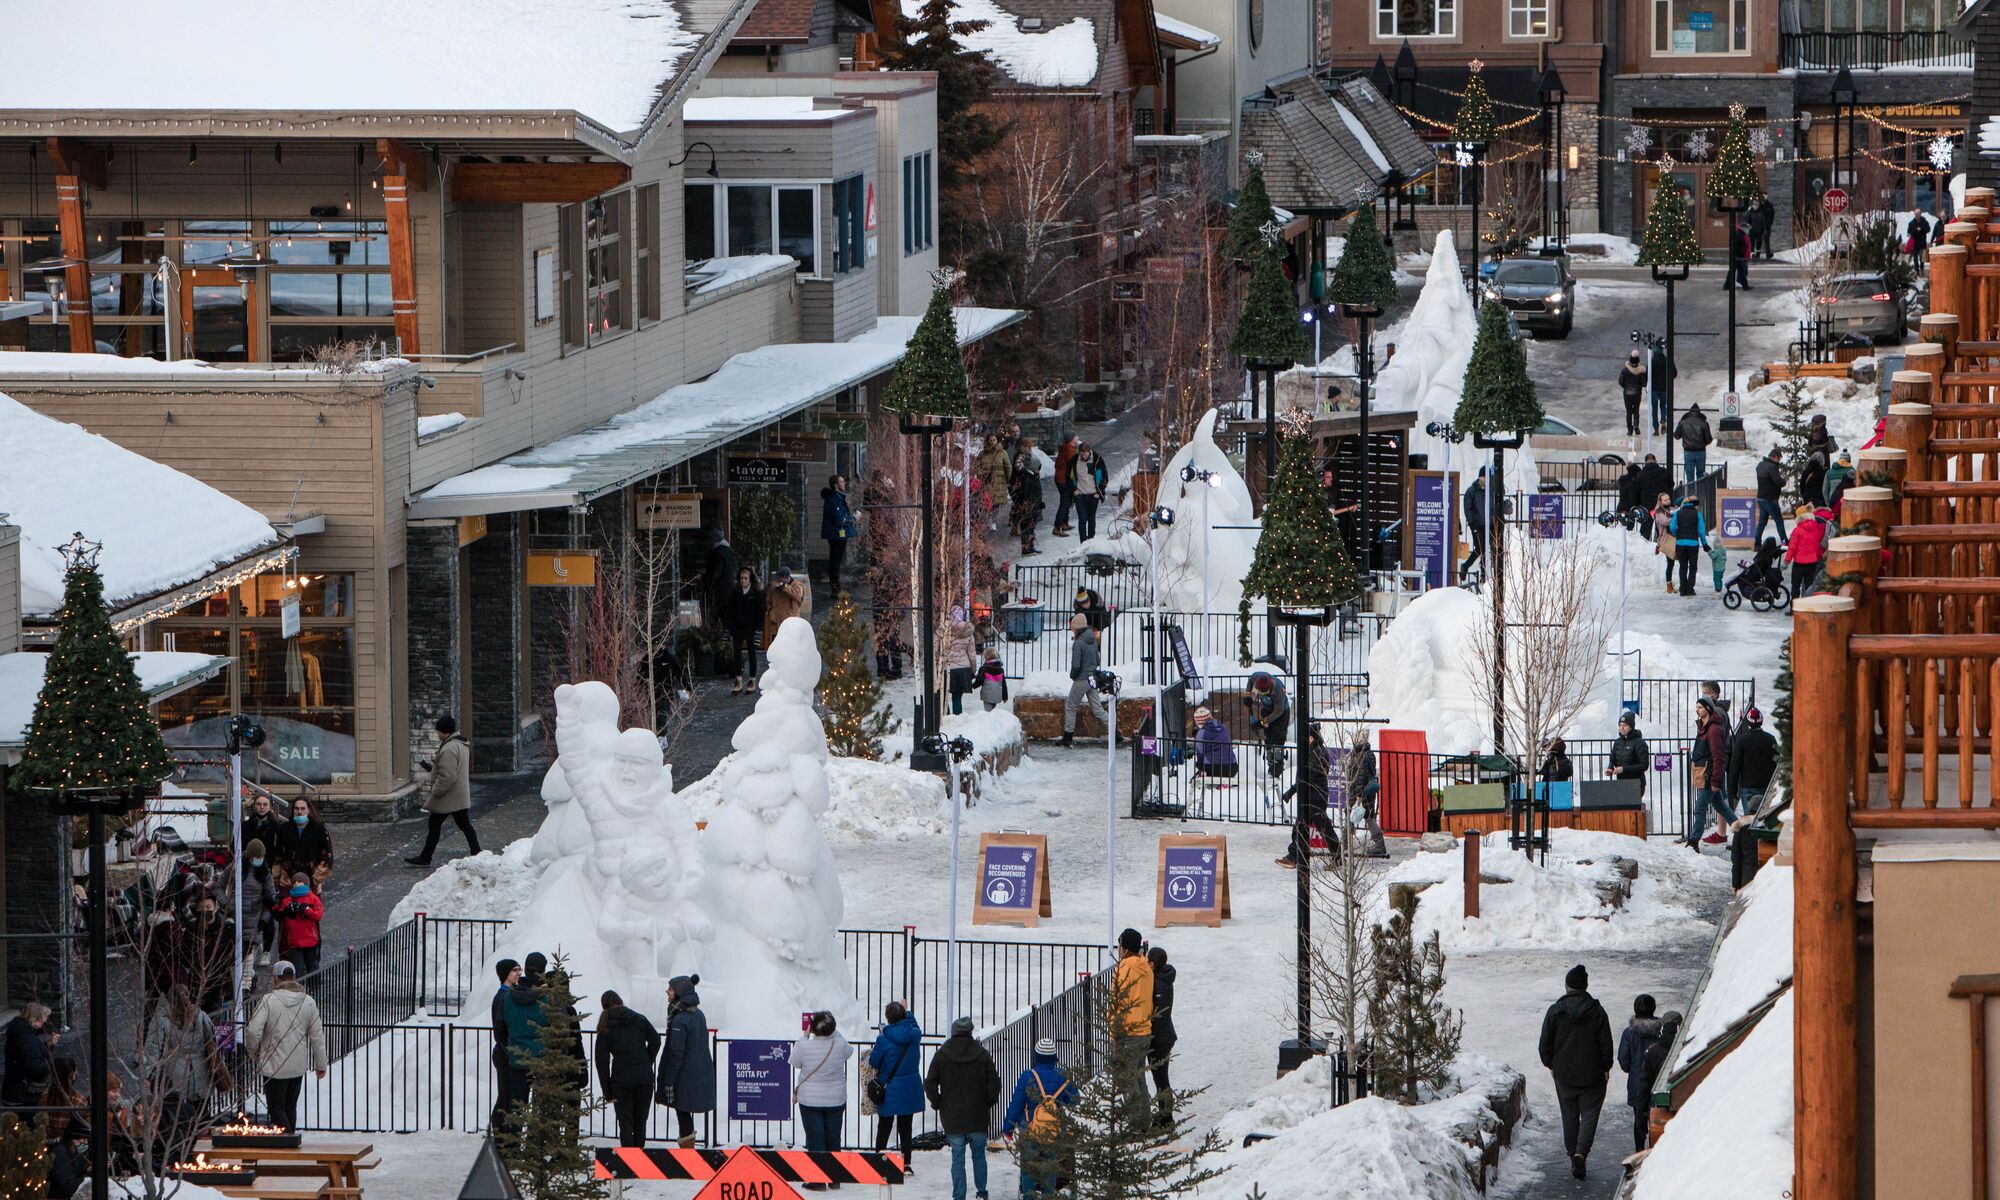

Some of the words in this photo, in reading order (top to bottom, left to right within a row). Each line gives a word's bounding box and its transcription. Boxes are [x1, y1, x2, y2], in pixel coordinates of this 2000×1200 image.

[1824, 197, 1847, 206] STOP
[736, 465, 778, 475] tavern
[1416, 501, 1442, 509] WELCOME
[279, 746, 320, 760] SALE
[988, 863, 1001, 871] FACE
[1001, 864, 1027, 872] COVERING
[988, 870, 1026, 878] RECOMMENDED
[736, 1070, 756, 1079] GOTTA
[720, 1181, 773, 1200] ROAD
